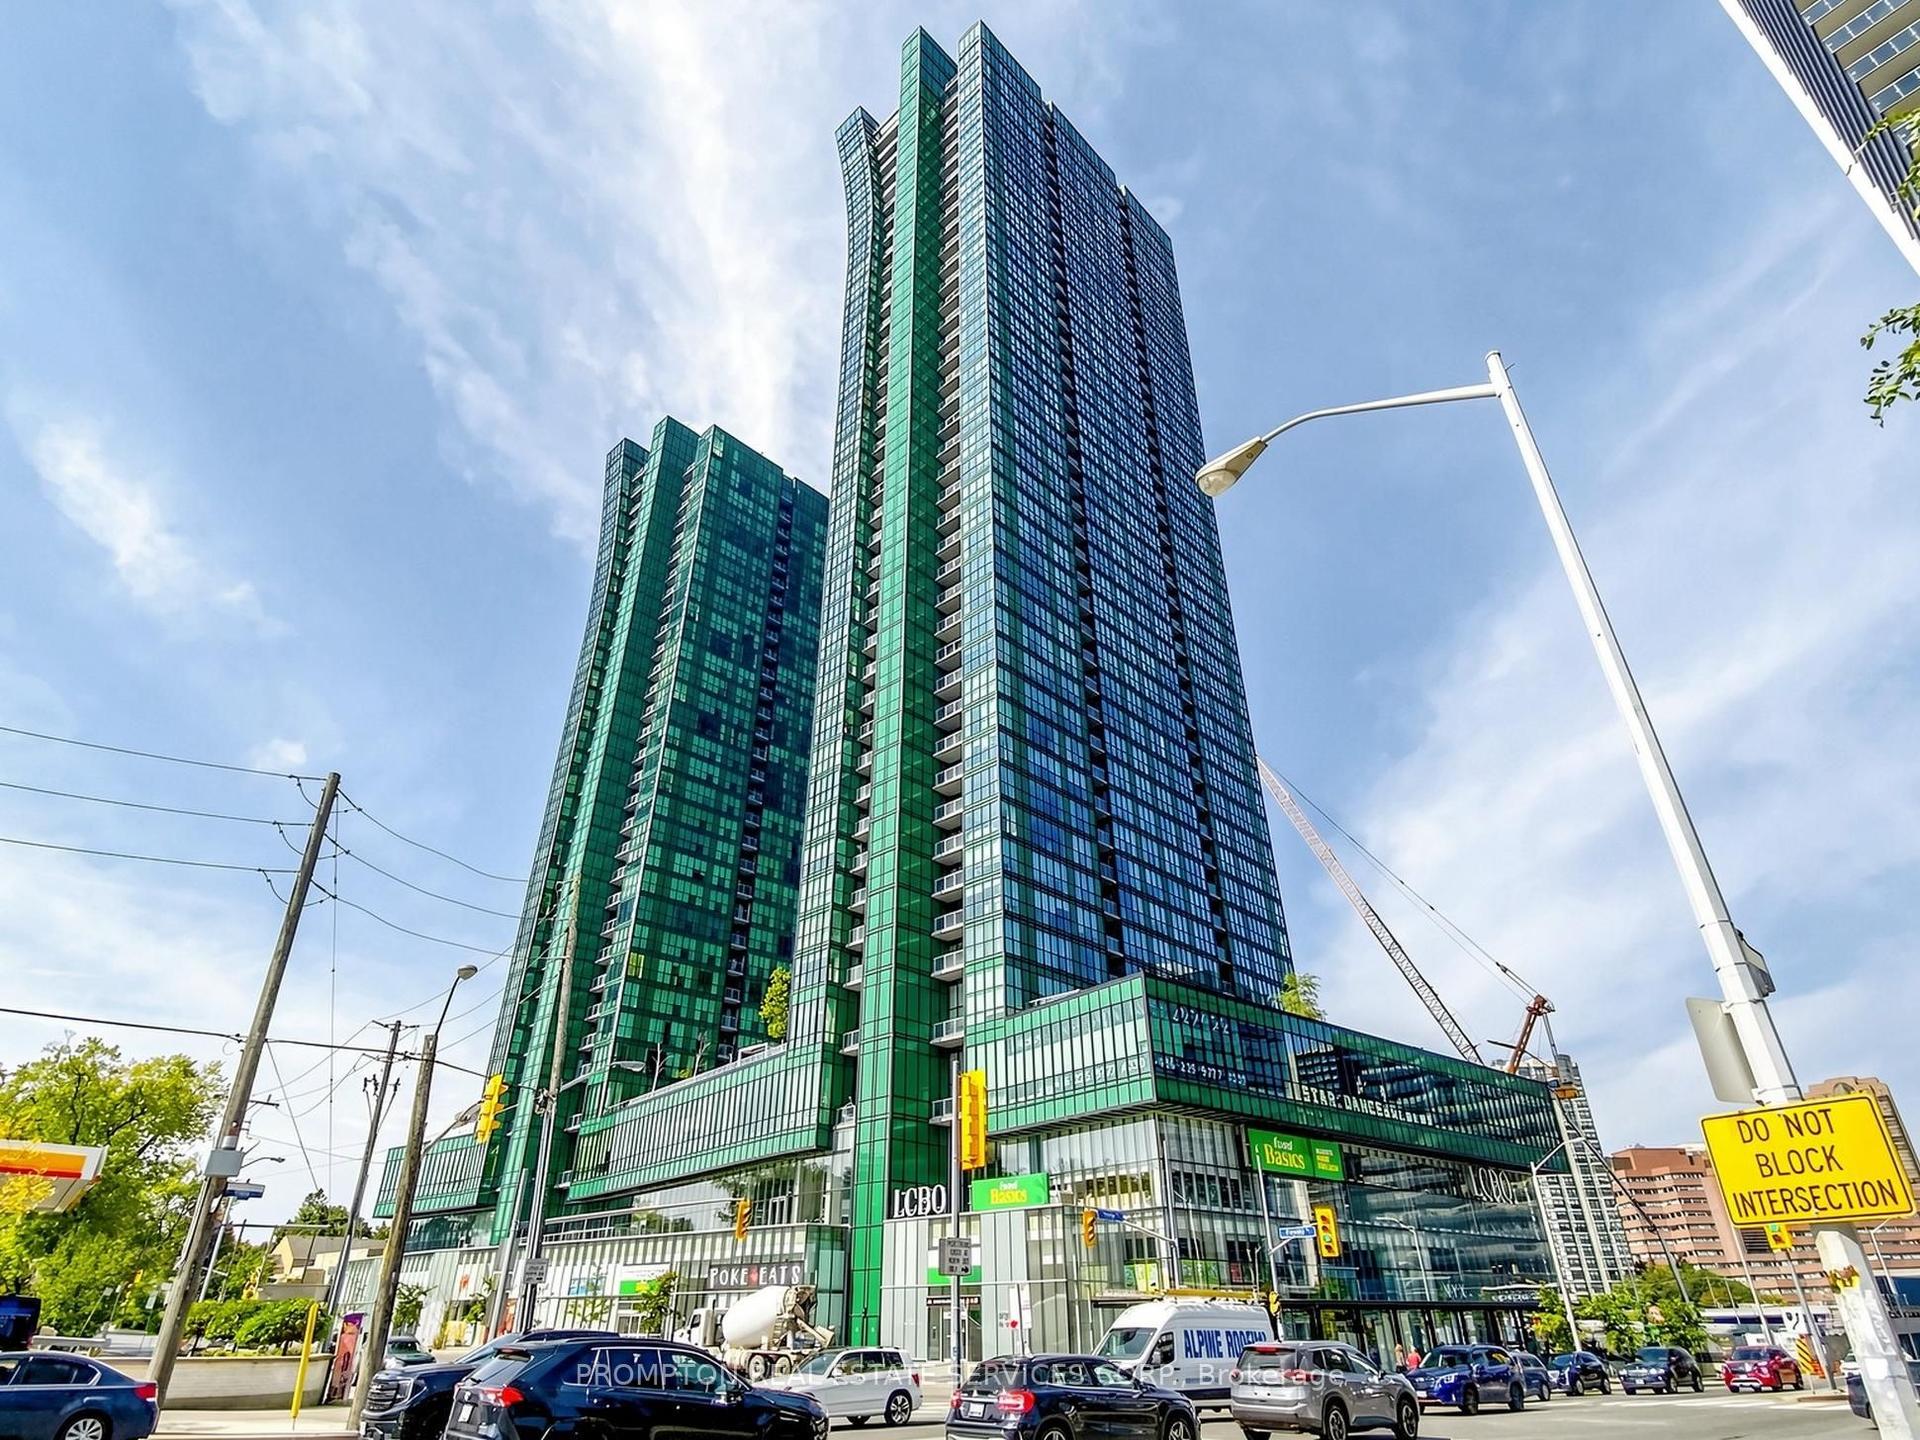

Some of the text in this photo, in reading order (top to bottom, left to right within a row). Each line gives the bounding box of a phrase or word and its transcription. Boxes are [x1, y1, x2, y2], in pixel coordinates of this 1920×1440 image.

[1736, 1108, 1836, 1144] DO NOT
[1263, 1143, 1306, 1169] Basics
[1755, 1145, 1844, 1179] BLOCK
[893, 1184, 947, 1218] LCBO
[1732, 1179, 1900, 1218] INTERSECTION
[709, 1264, 801, 1289] POKE EATS
[1183, 1329, 1224, 1358] ALPINE
